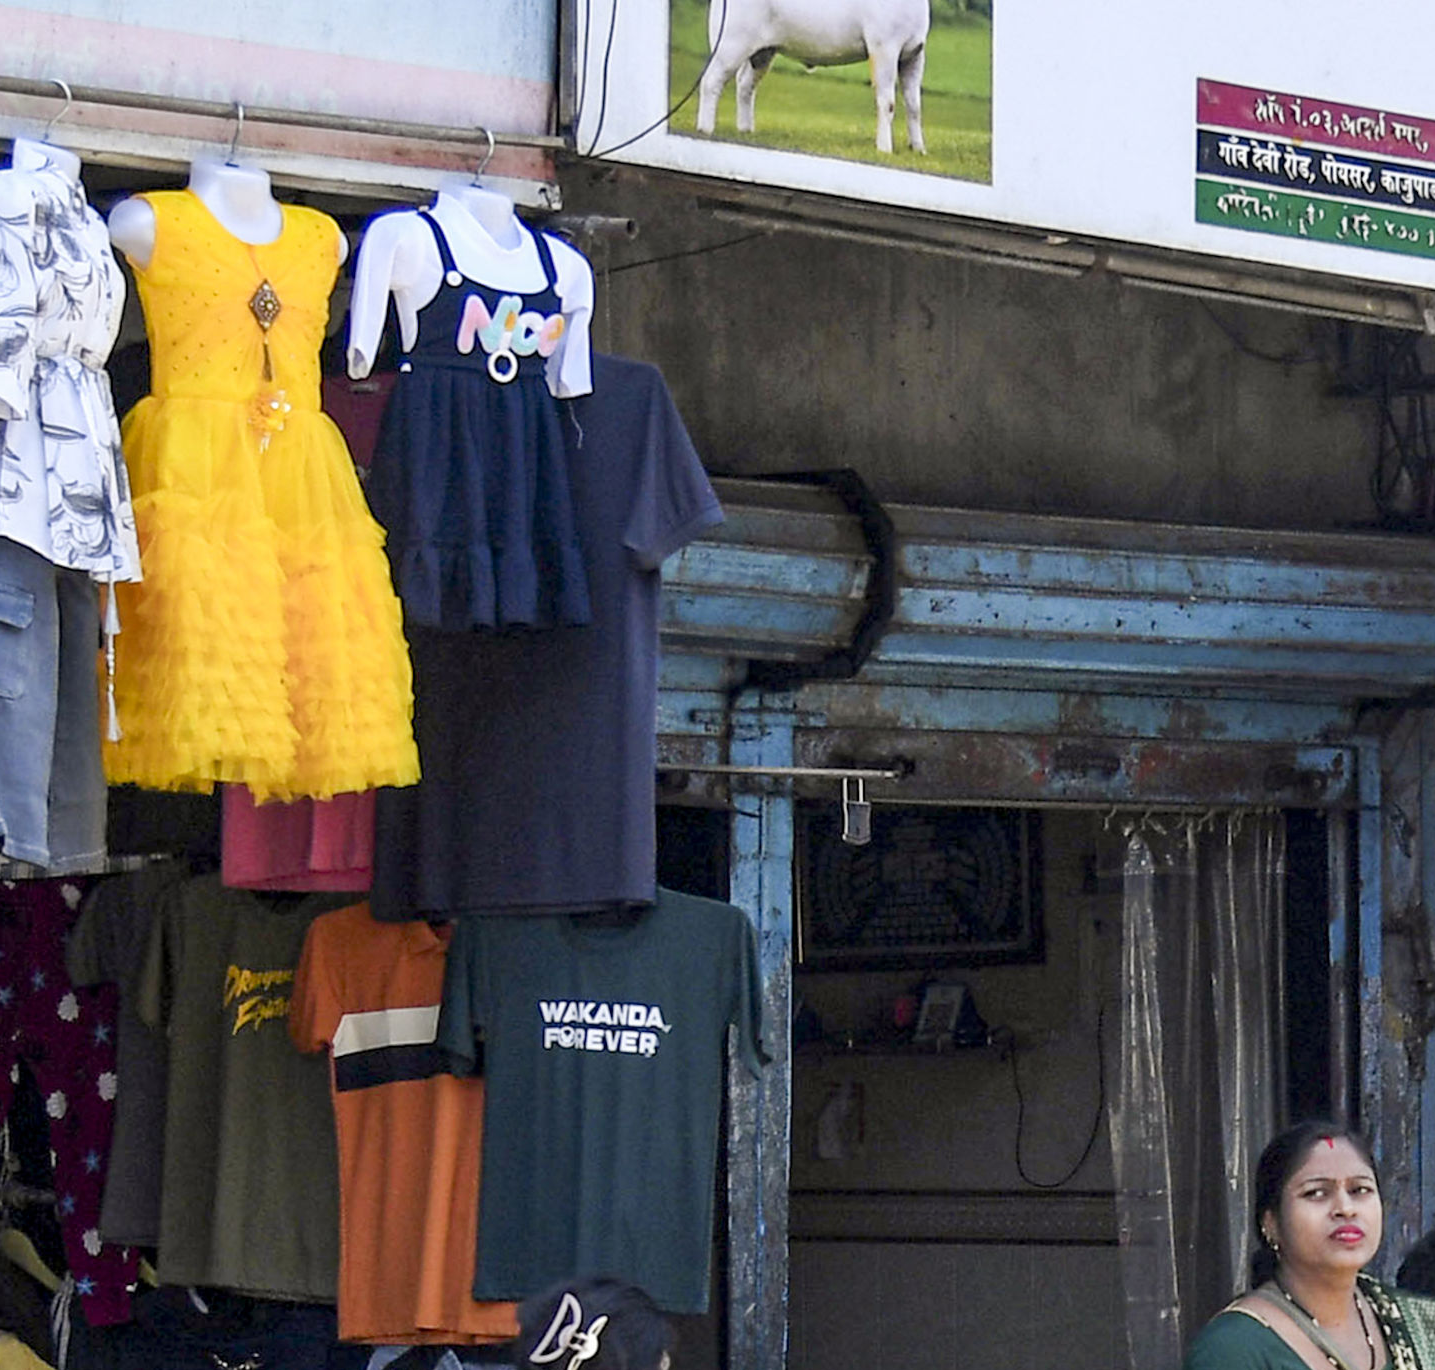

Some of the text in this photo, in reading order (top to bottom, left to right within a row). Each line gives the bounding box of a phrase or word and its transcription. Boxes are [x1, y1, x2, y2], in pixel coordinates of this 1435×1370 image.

[1218, 136, 1249, 169] गाँव
[1250, 140, 1282, 175] देवी
[1284, 145, 1316, 184] रोड,
[1320, 152, 1376, 193] पोयसर,
[539, 1001, 669, 1031] WAKANDA
[543, 1026, 660, 1057] FOREVER
